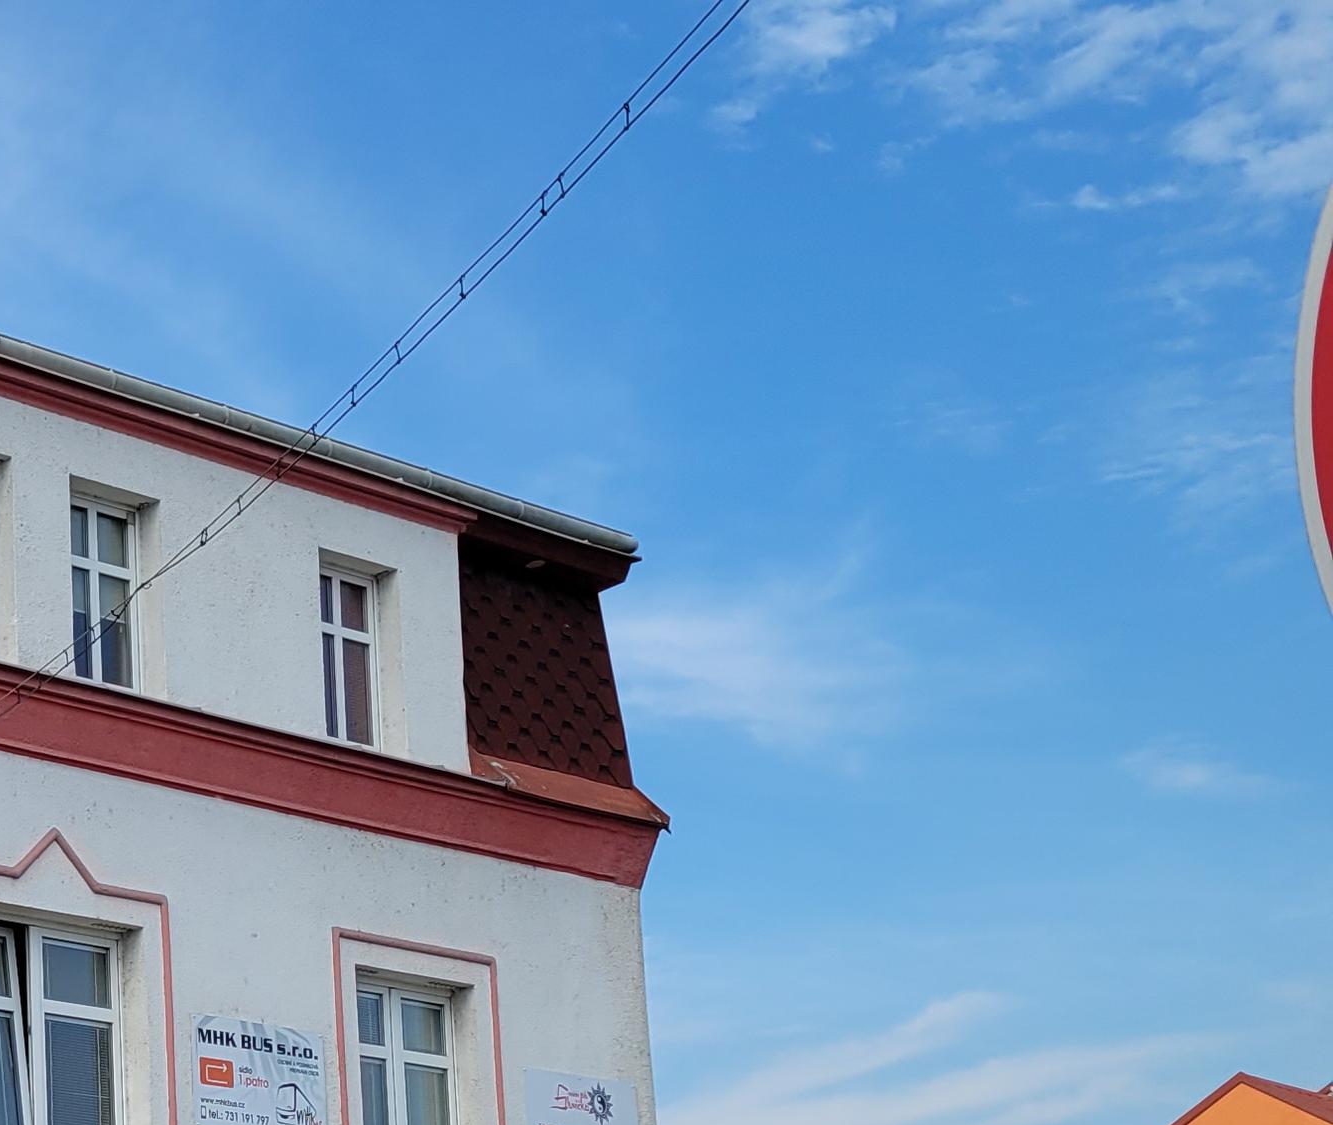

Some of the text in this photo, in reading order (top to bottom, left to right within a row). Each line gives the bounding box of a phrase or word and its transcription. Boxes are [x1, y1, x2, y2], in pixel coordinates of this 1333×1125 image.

[198, 1027, 318, 1060] MHK BUS s.r.o.
[225, 1110, 238, 1122] 731
[242, 1112, 253, 1123] 191
[256, 1114, 269, 1125] 797
